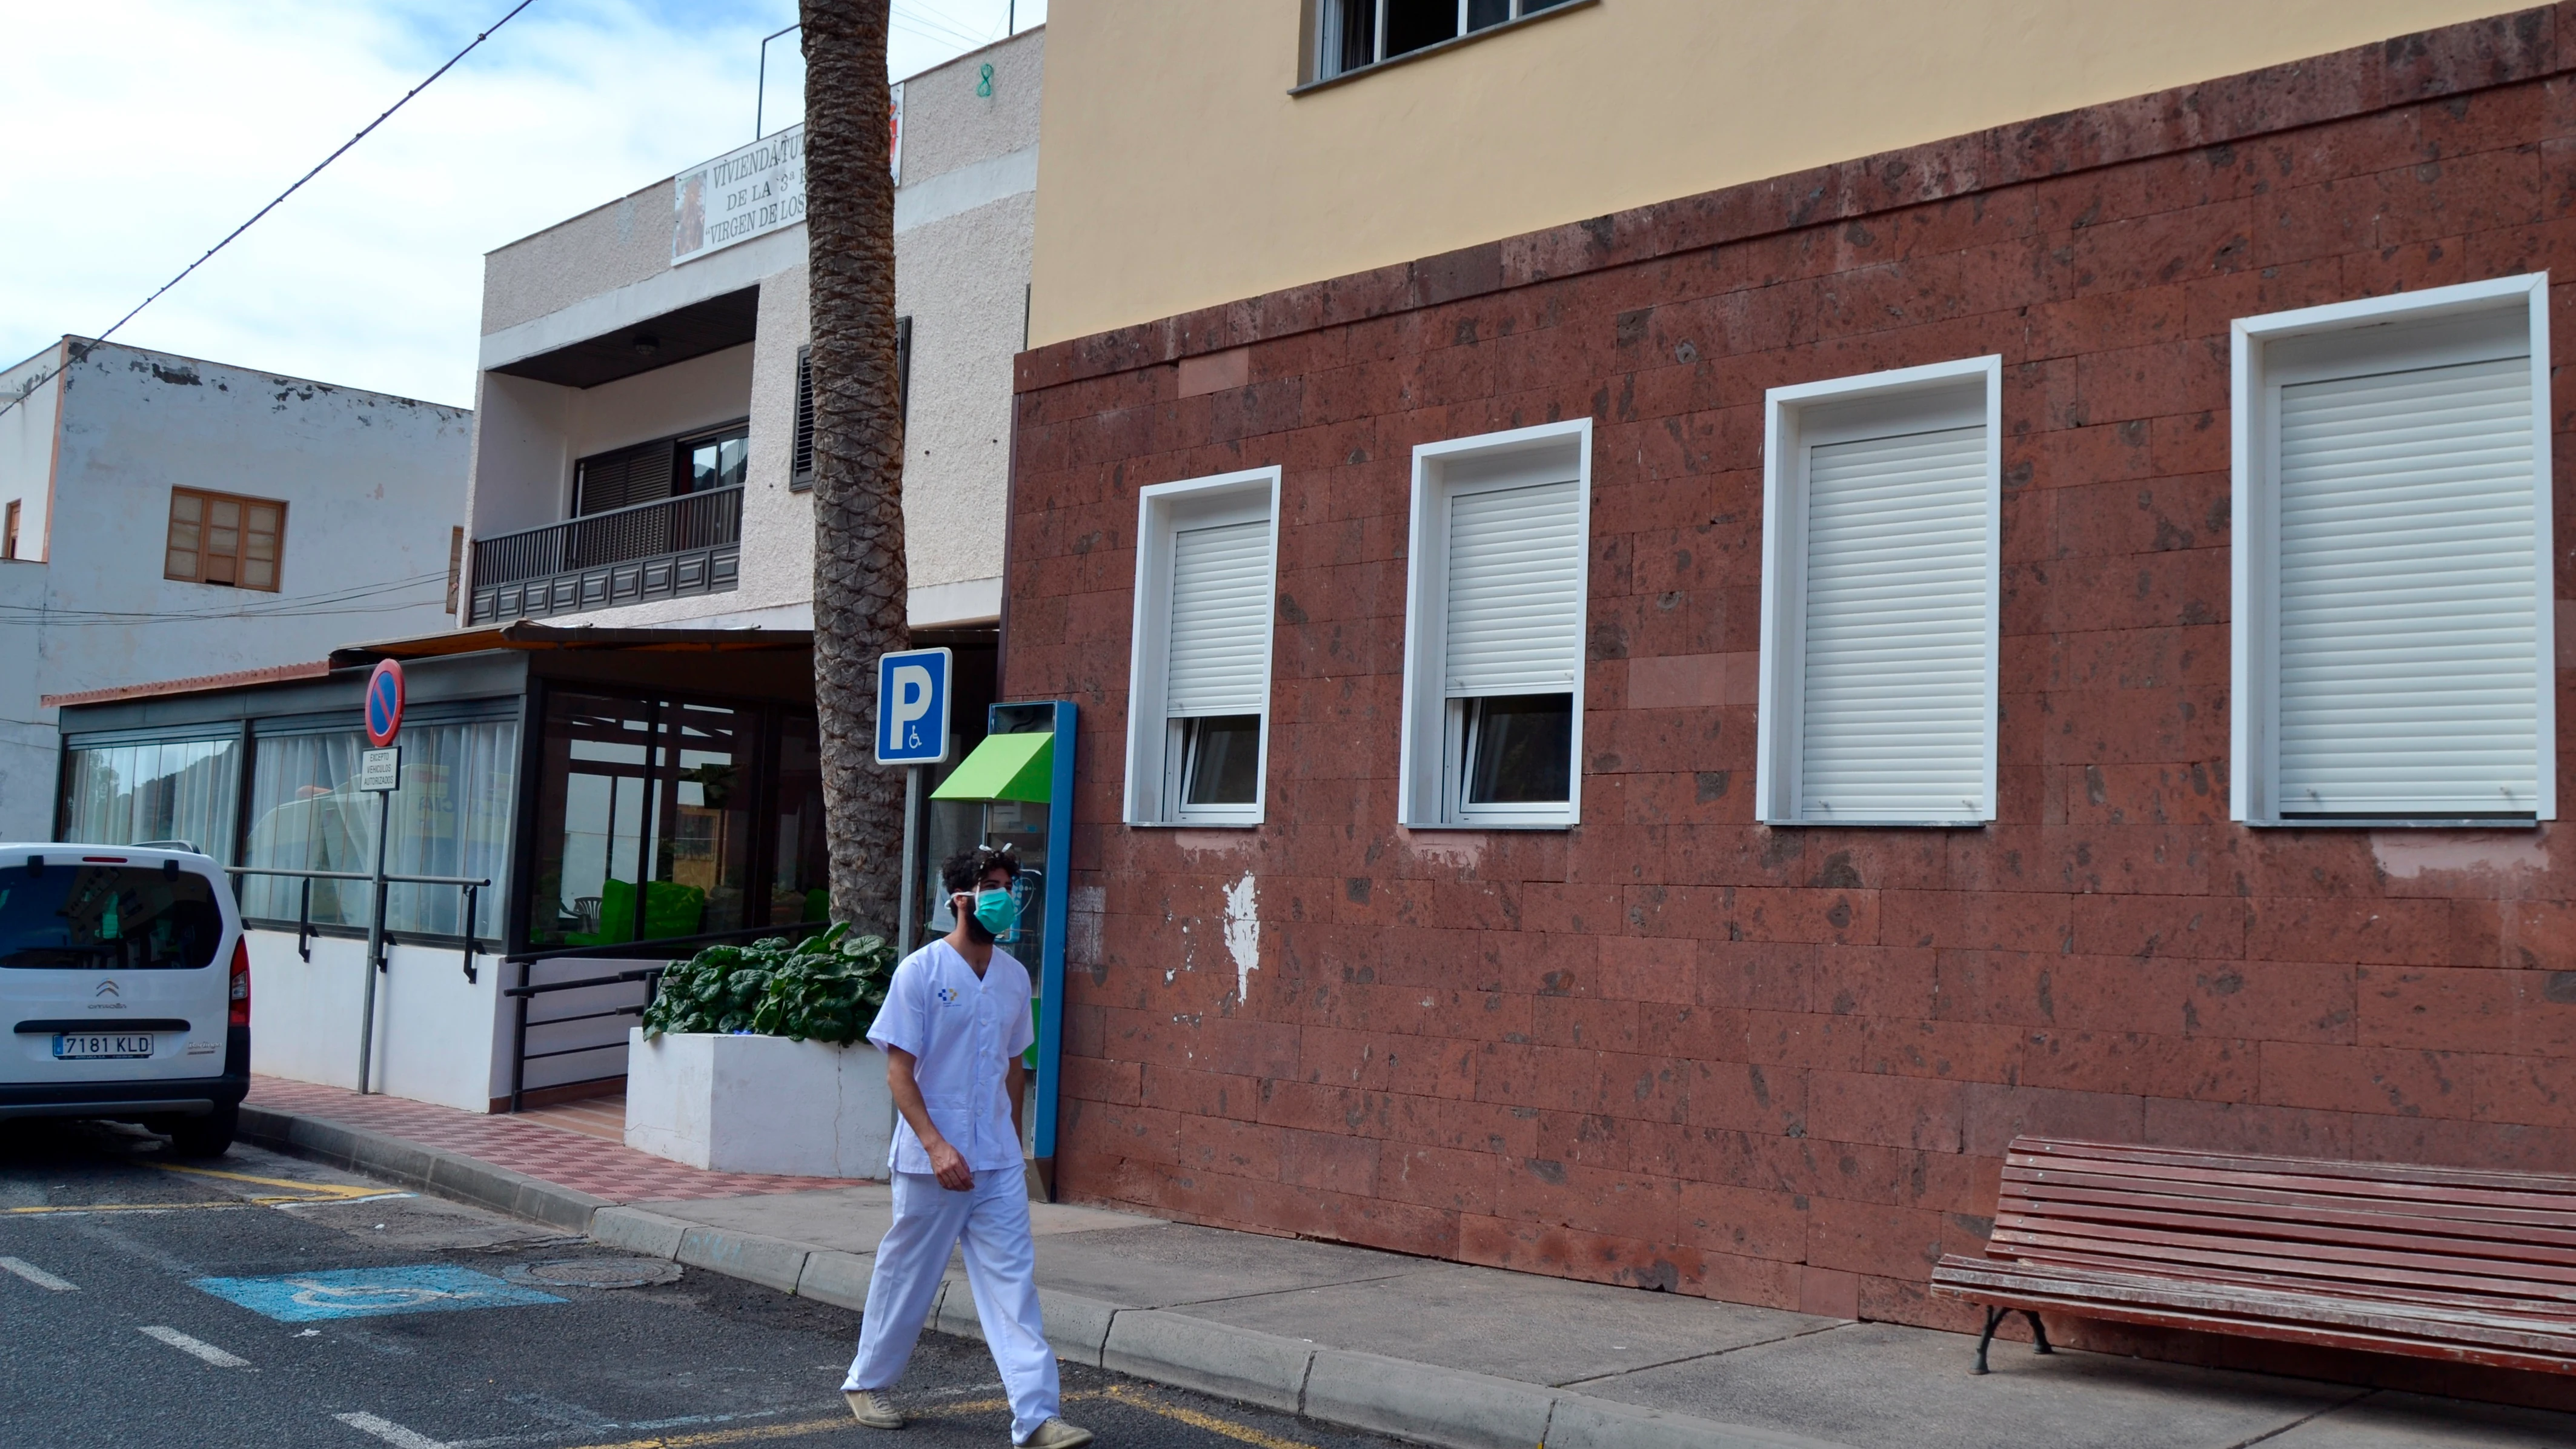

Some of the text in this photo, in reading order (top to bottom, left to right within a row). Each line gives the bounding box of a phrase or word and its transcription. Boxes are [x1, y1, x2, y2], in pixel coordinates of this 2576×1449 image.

[713, 144, 778, 189] VIVIENDA
[727, 188, 747, 211] DE
[752, 181, 771, 202] LA
[759, 204, 778, 227] DE
[781, 193, 805, 220] LOS
[890, 665, 932, 750] P
[370, 752, 389, 761] EXCEPTO
[367, 763, 391, 774] VEHICULOS
[363, 775, 393, 786] AUTORIZADOS
[67, 1038, 108, 1053] 7181
[117, 1037, 148, 1052] KLD
